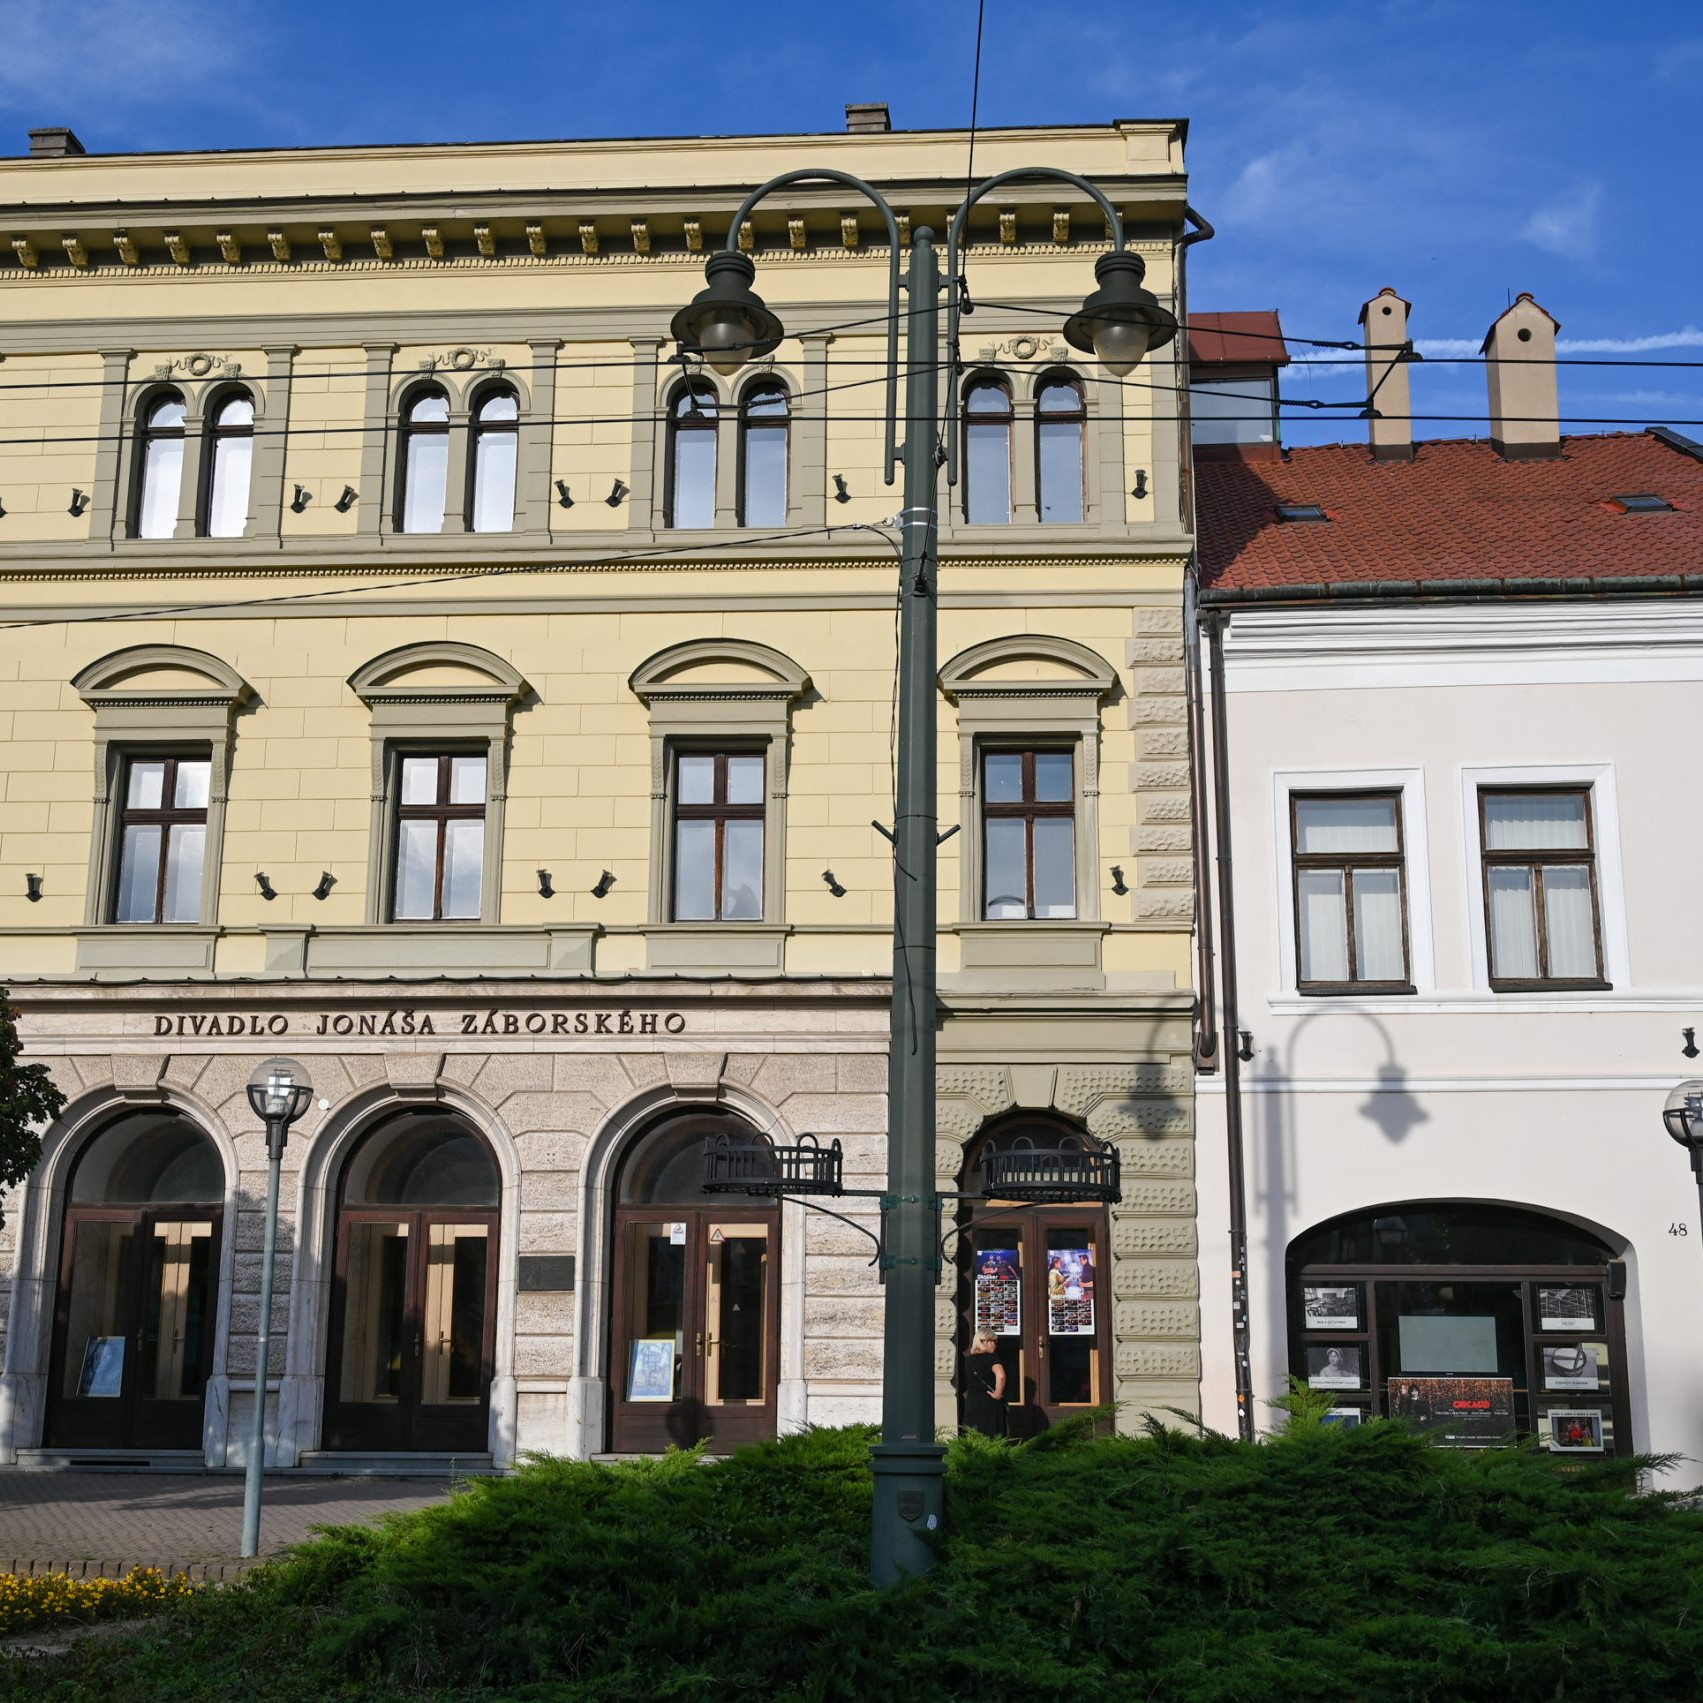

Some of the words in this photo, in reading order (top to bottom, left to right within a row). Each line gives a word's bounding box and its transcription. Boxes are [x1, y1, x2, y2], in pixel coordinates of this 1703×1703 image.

[153, 1014, 289, 1036] DIVADLO
[316, 1009, 436, 1036] JONÁŠA
[460, 1008, 686, 1035] ZÁBORSKÉHO
[1668, 1222, 1688, 1237] 48
